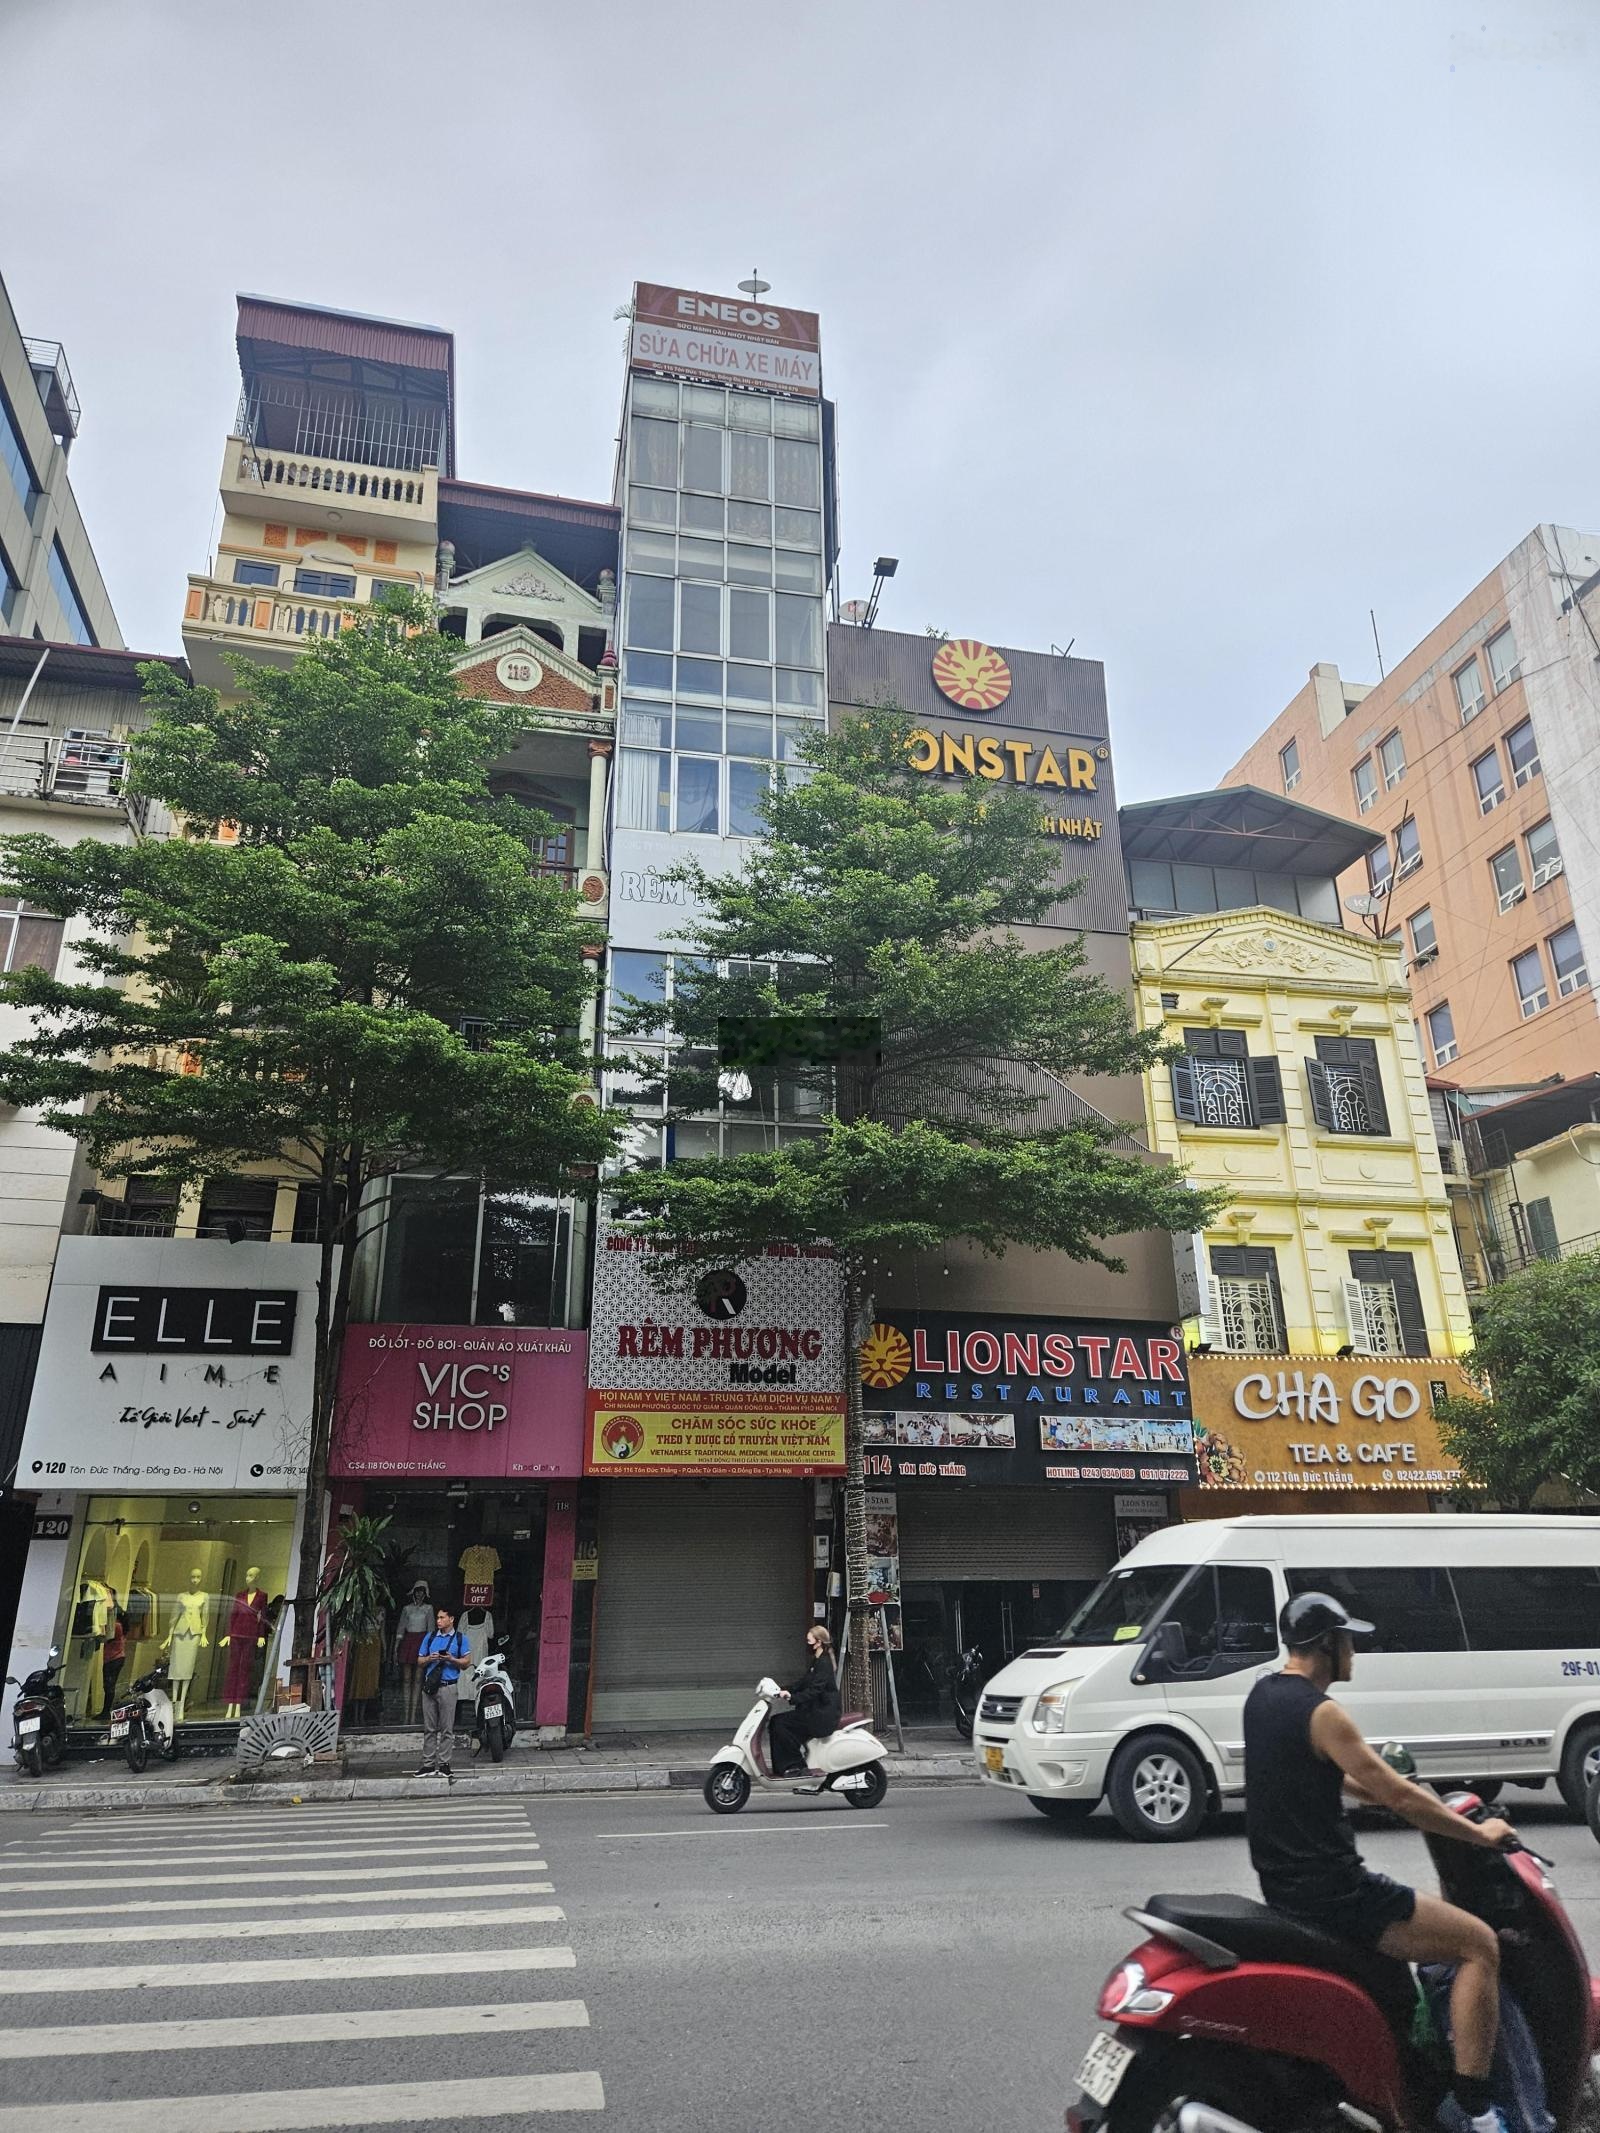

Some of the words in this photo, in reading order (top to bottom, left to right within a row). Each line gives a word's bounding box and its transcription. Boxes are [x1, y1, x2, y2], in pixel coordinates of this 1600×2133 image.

[677, 296, 781, 330] ENEOS
[639, 329, 680, 358] SỬA
[686, 341, 739, 368] CHỮA
[745, 351, 769, 374] XE
[775, 354, 813, 381] MÁY
[904, 727, 1098, 792] ONSTAR
[102, 1297, 286, 1344] ELLE
[464, 1336, 495, 1351] QUẦN
[498, 1338, 514, 1351] ÁO
[692, 1325, 823, 1362] PHƯƠNG
[913, 1329, 1185, 1382] LIONSTAR
[99, 1362, 279, 1385] AIME
[730, 1363, 797, 1385] Model
[620, 1392, 642, 1401] NAM
[643, 1392, 651, 1401] Y
[654, 1392, 677, 1403] VIỆT
[678, 1393, 701, 1402] NAM
[710, 1393, 744, 1402] TRUNG
[746, 1392, 767, 1403] TÂM
[769, 1394, 793, 1405] DỊCH
[795, 1394, 808, 1405] VỤ
[810, 1395, 832, 1403] NAM
[834, 1395, 841, 1404] Y
[916, 1382, 1186, 1406] RESTAURANT
[1234, 1371, 1343, 1424] CHA
[1351, 1375, 1421, 1423] GO
[1433, 1383, 1445, 1398] 茶
[174, 1406, 209, 1429] Vest
[227, 1408, 266, 1429] Suit
[413, 1402, 507, 1431] SHOP
[671, 1416, 713, 1430] CHĂM
[717, 1416, 746, 1430] SÓC
[750, 1416, 777, 1430] SỨC
[781, 1416, 817, 1431] KHỎE
[656, 1434, 683, 1445] THEO
[685, 1434, 694, 1445] Y
[738, 1431, 778, 1446] TRUYỀN
[781, 1433, 804, 1448] VIỆT
[806, 1435, 830, 1446] NAM
[694, 1449, 736, 1457] TRADITIONAL
[1289, 1443, 1334, 1464] TEA
[1336, 1444, 1352, 1463] &
[1357, 1443, 1417, 1464] CAFE
[45, 1462, 66, 1474] 120
[70, 1465, 86, 1475] Tôn
[90, 1465, 109, 1475] Đức
[112, 1465, 140, 1477] Thắng
[208, 1465, 223, 1476] Nội
[863, 1455, 892, 1475] 114
[899, 1462, 916, 1475] TÔN
[919, 1461, 937, 1475] ĐỨC
[939, 1460, 967, 1477] THẮNG
[1046, 1467, 1080, 1478] HOTLINE:
[1121, 1468, 1136, 1479] 888
[1170, 1469, 1189, 1480] 2222
[1267, 1472, 1280, 1482] 112
[1282, 1471, 1300, 1482] Tôn
[1303, 1471, 1321, 1482] Đức
[1323, 1469, 1353, 1484] Thắng
[556, 1502, 569, 1511] 118
[34, 1520, 69, 1535] 120
[470, 1586, 489, 1595] SALE
[471, 1595, 486, 1604] OFF
[1500, 1738, 1547, 1747] DCAR
